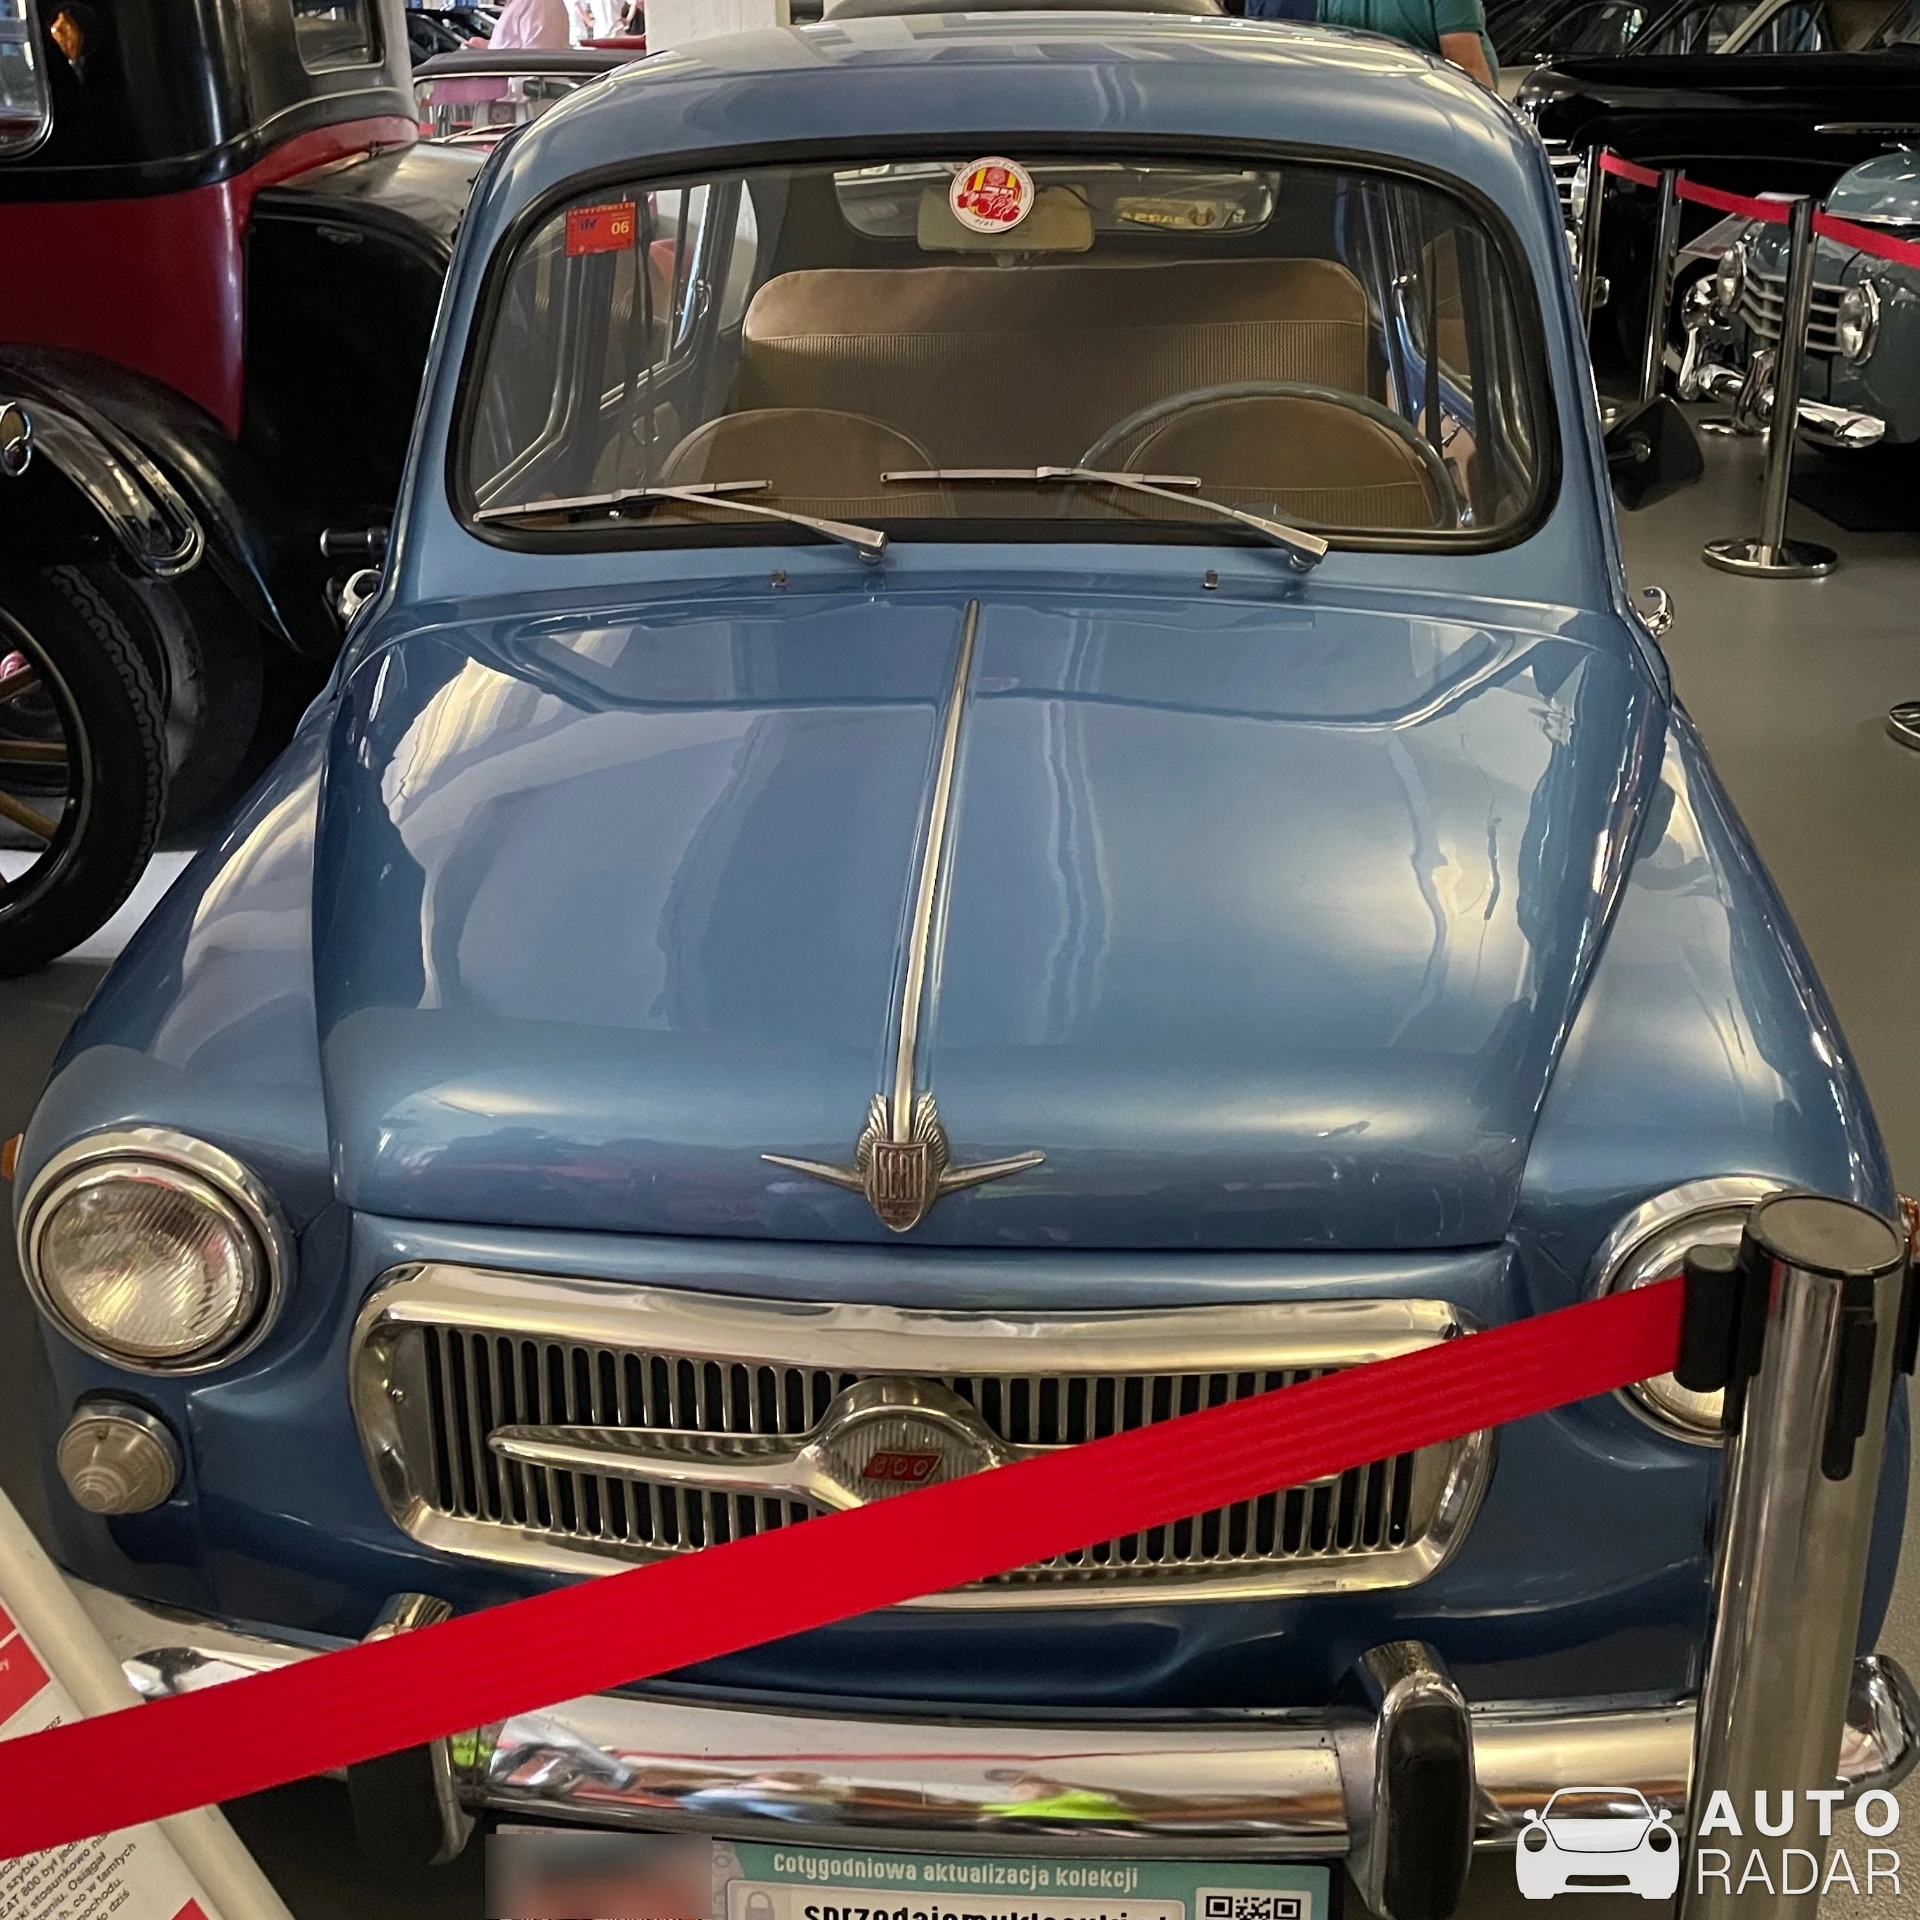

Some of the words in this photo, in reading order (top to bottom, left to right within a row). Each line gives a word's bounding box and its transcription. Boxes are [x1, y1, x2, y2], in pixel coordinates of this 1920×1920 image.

[611, 220, 630, 236] 06
[879, 1149, 921, 1199] SEAT
[873, 1456, 929, 1477] 800
[0, 1893, 19, 1919] EAT
[20, 1875, 41, 1897] 800
[41, 1857, 59, 1878] był
[6, 1854, 39, 1891] szybki
[30, 1848, 90, 1909] stosunkowo
[67, 1851, 106, 1891] Osiągał
[73, 1893, 86, 1908] co
[86, 1881, 97, 1893] w
[96, 1842, 137, 1883] tamtych
[773, 1852, 917, 1881] Cotygodniowa
[923, 1862, 1050, 1890] aktualizacja
[1055, 1867, 1138, 1893] kolekcji
[109, 1887, 130, 1913] dziś
